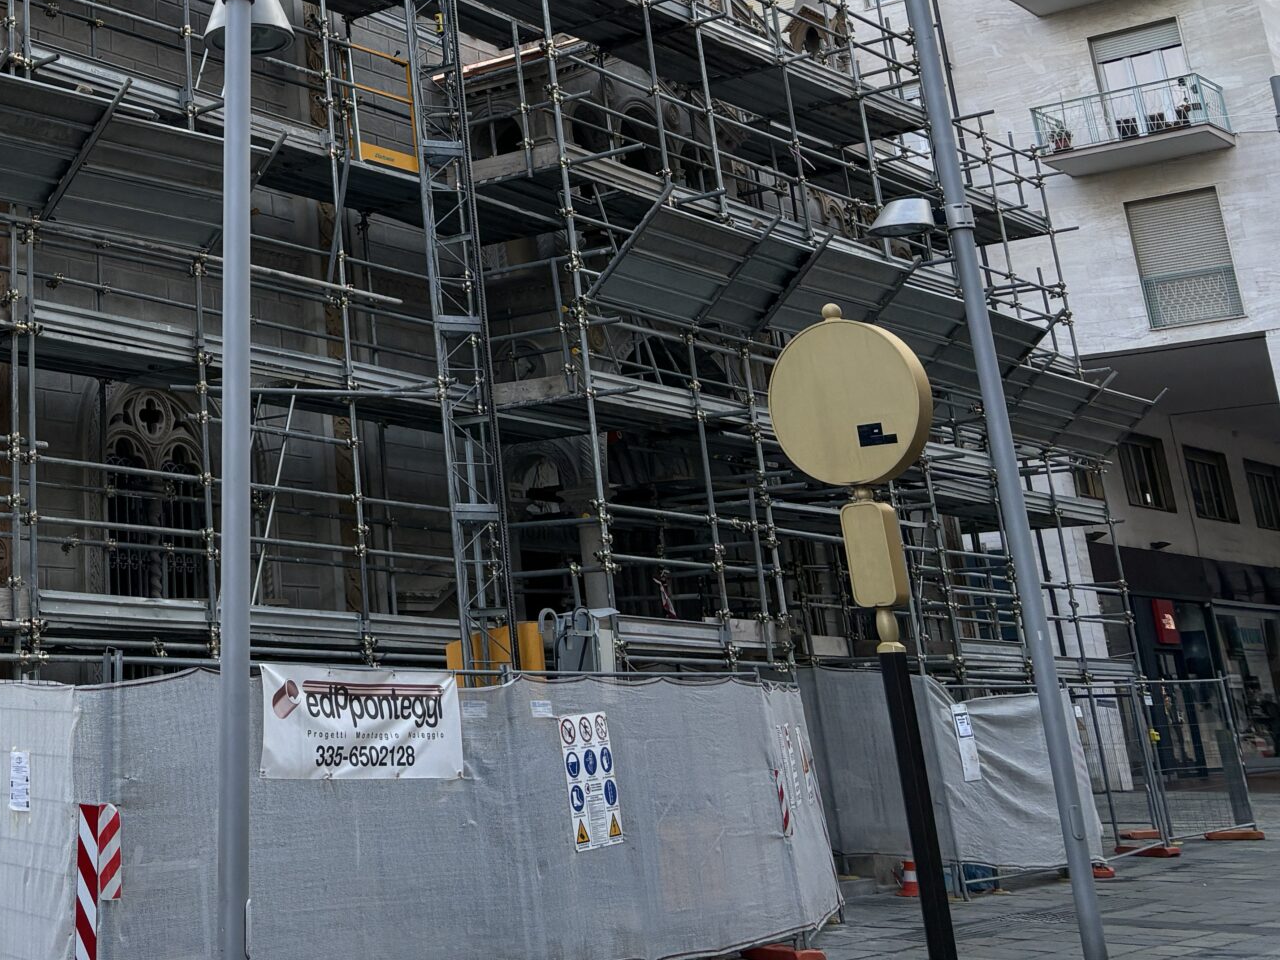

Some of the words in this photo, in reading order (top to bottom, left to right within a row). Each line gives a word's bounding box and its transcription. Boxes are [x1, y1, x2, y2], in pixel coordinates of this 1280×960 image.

[307, 729, 347, 740] Progetti
[355, 731, 400, 741] Montaggio
[315, 745, 415, 767] 335-6502128
